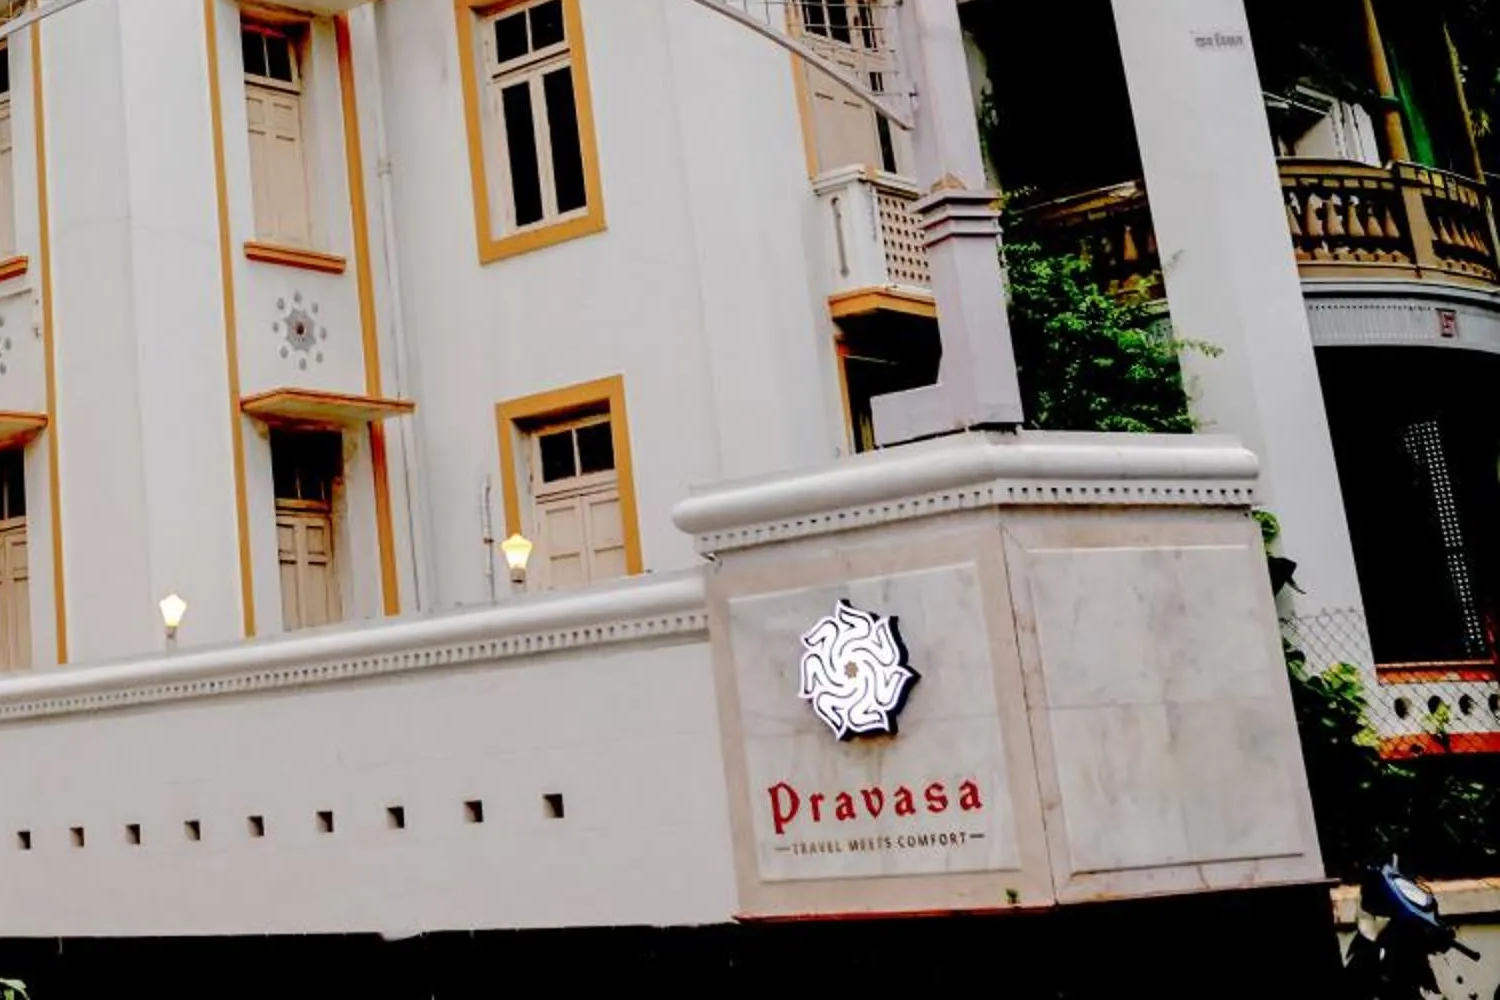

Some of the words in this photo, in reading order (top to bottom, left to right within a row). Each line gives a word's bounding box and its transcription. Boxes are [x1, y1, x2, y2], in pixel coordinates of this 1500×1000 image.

[767, 776, 984, 835] Pravasa
[791, 839, 844, 856] TRAVEL
[848, 836, 893, 852] MEETS
[896, 831, 967, 849] COMFORT
